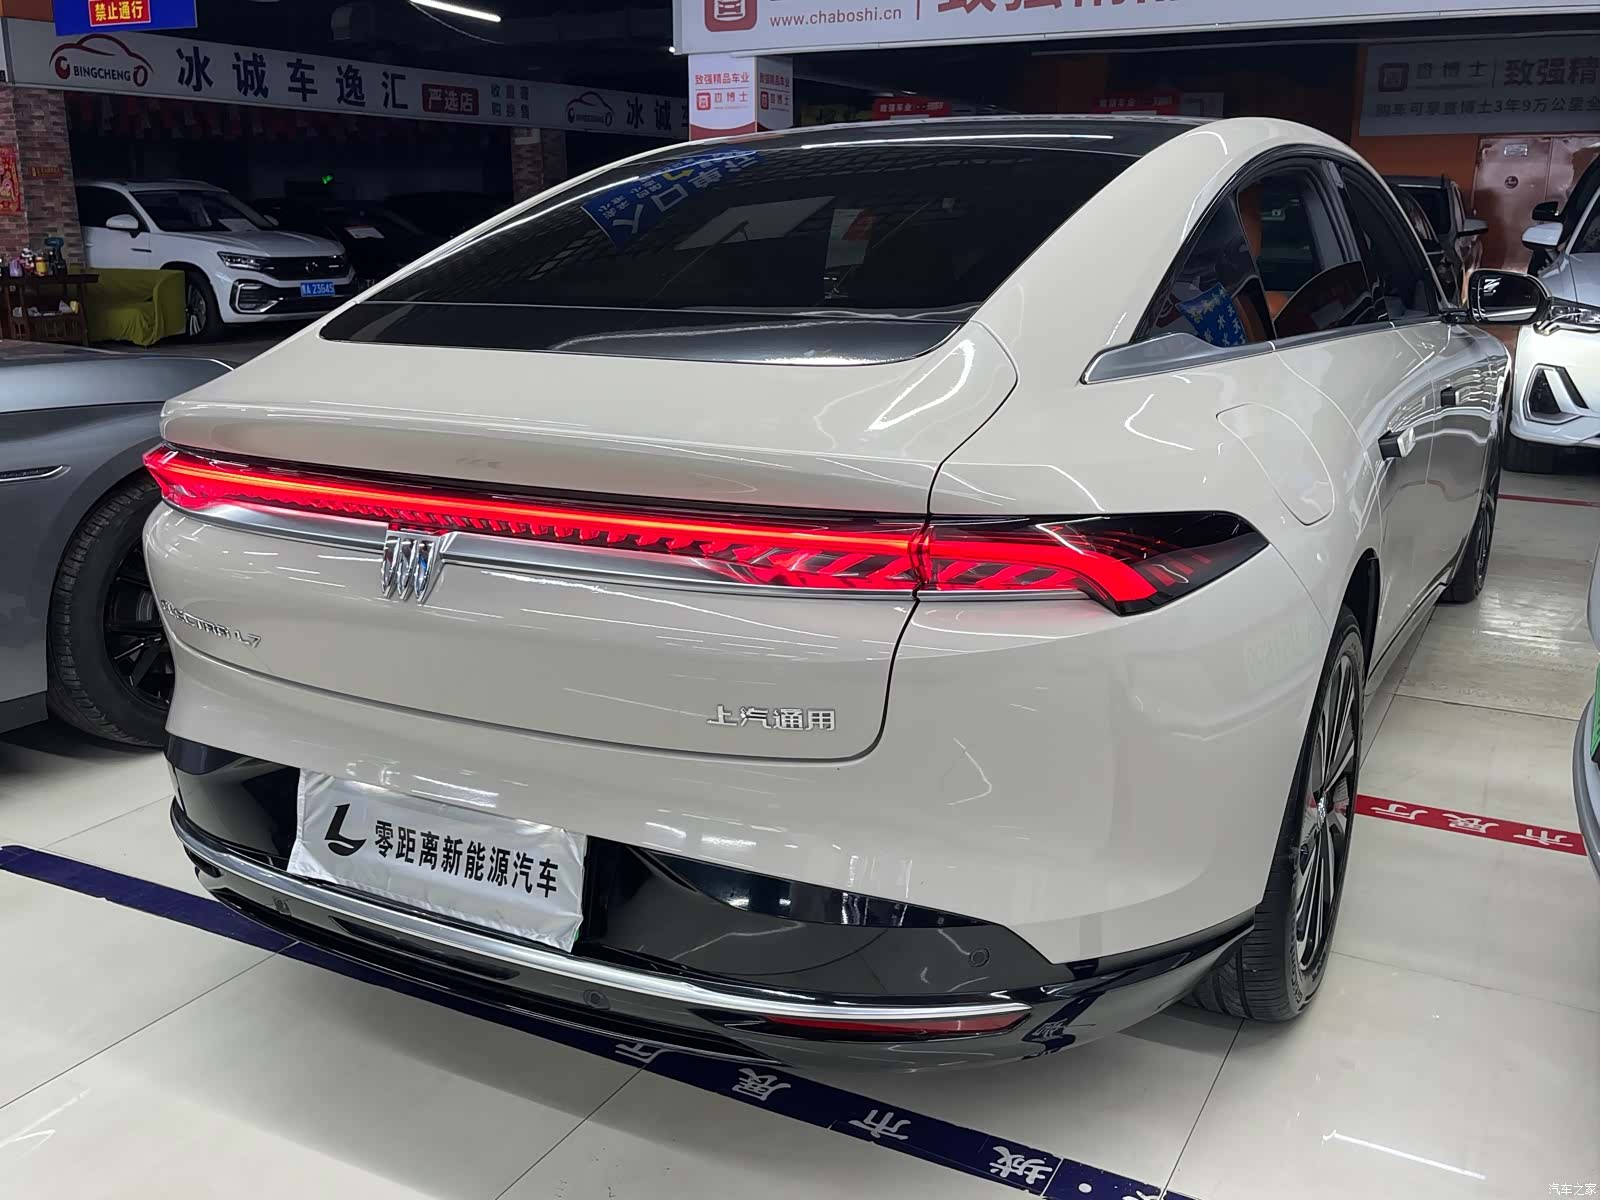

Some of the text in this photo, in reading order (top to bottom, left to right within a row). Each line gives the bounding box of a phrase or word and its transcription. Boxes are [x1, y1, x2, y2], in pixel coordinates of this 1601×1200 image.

[95, 2, 143, 21] 禁止通行
[770, 7, 902, 27] www.chaboshi.cn
[73, 66, 131, 83] BINGCHENG
[176, 46, 409, 109] 冰诚车逸汇
[695, 72, 749, 85] 致强精品车业
[427, 87, 474, 112] 严选店
[234, 629, 262, 648] L7
[707, 703, 836, 731] 上汽通用
[375, 819, 559, 898] 零距离新能源汽车
